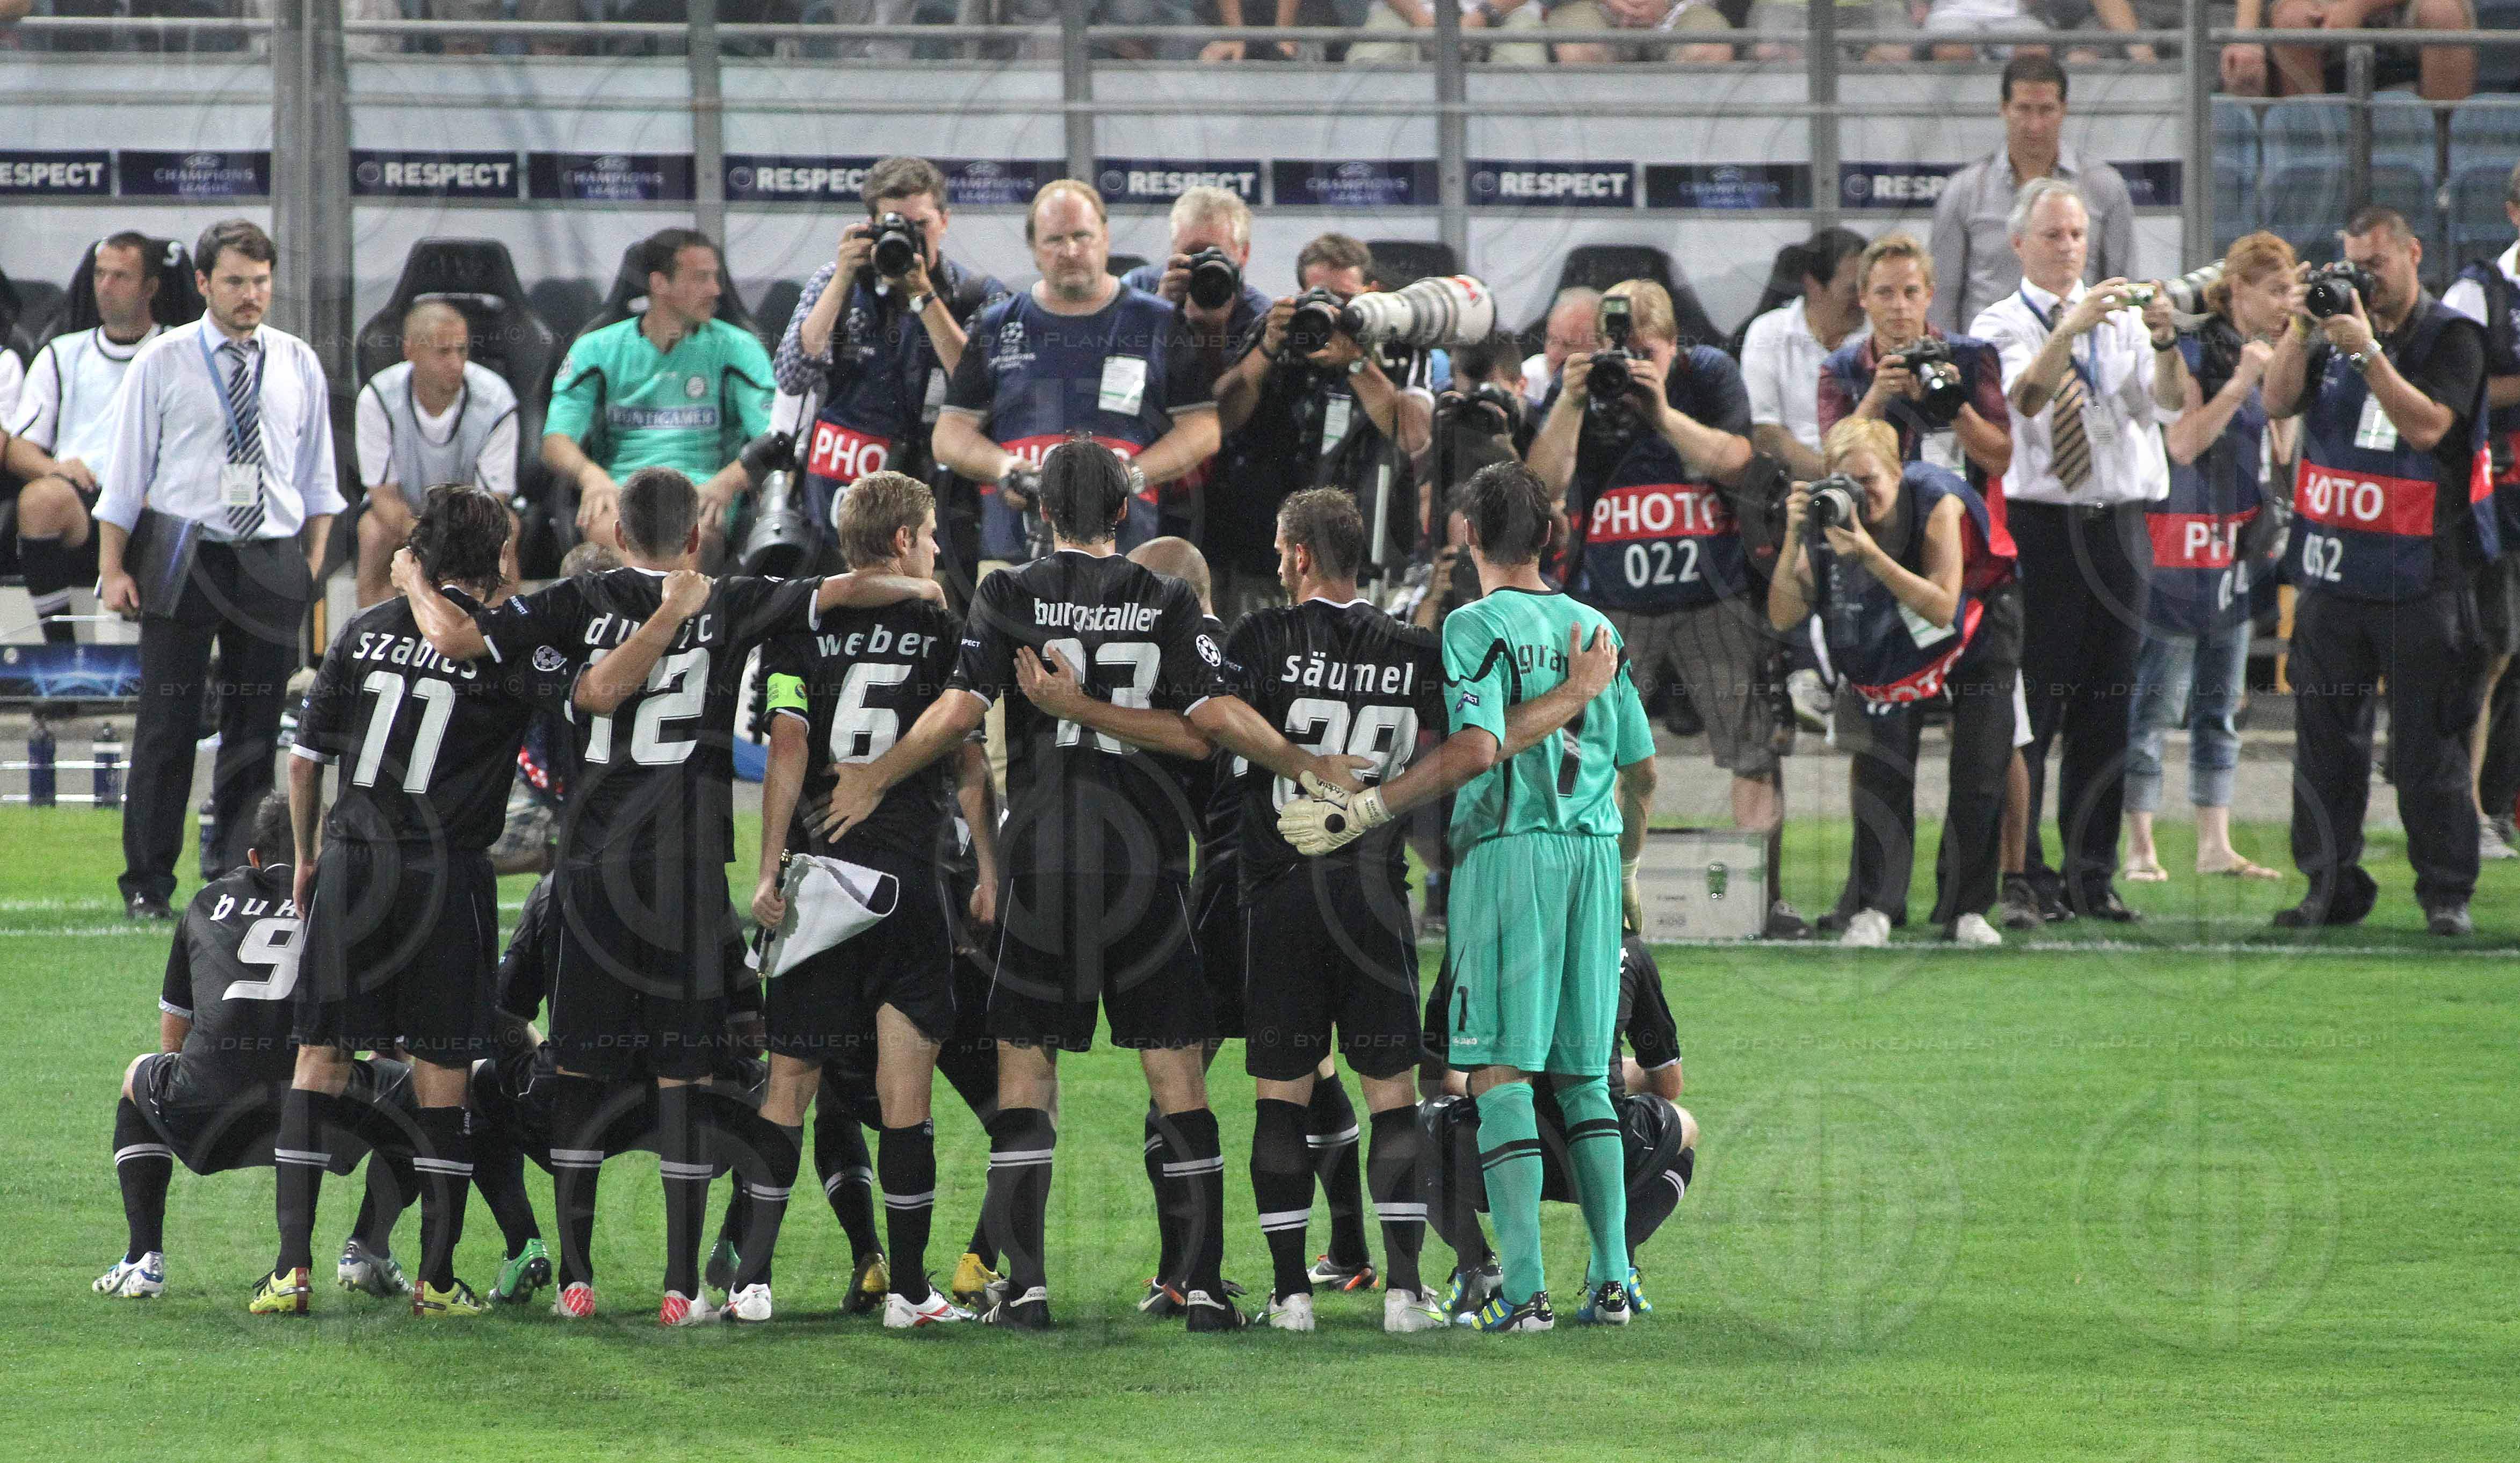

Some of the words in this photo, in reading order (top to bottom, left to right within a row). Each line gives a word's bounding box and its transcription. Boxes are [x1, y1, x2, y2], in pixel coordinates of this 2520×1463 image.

[0, 162, 104, 186] ESPECT
[385, 162, 511, 187] RESPECT
[756, 167, 868, 192] RESPEC
[1128, 171, 1255, 195] RESPECT
[1500, 172, 1630, 197] RESPECT
[1873, 175, 1950, 198] RESP
[812, 427, 889, 479] PHO
[1624, 539, 1700, 588] 022
[584, 612, 713, 649] duic
[1034, 597, 1163, 633] burgstaller
[816, 624, 938, 660] weber
[1280, 651, 1414, 696] säumel
[829, 662, 913, 764] 6
[352, 671, 456, 794] 11
[209, 893, 296, 921] buk
[221, 917, 305, 1001] 9
